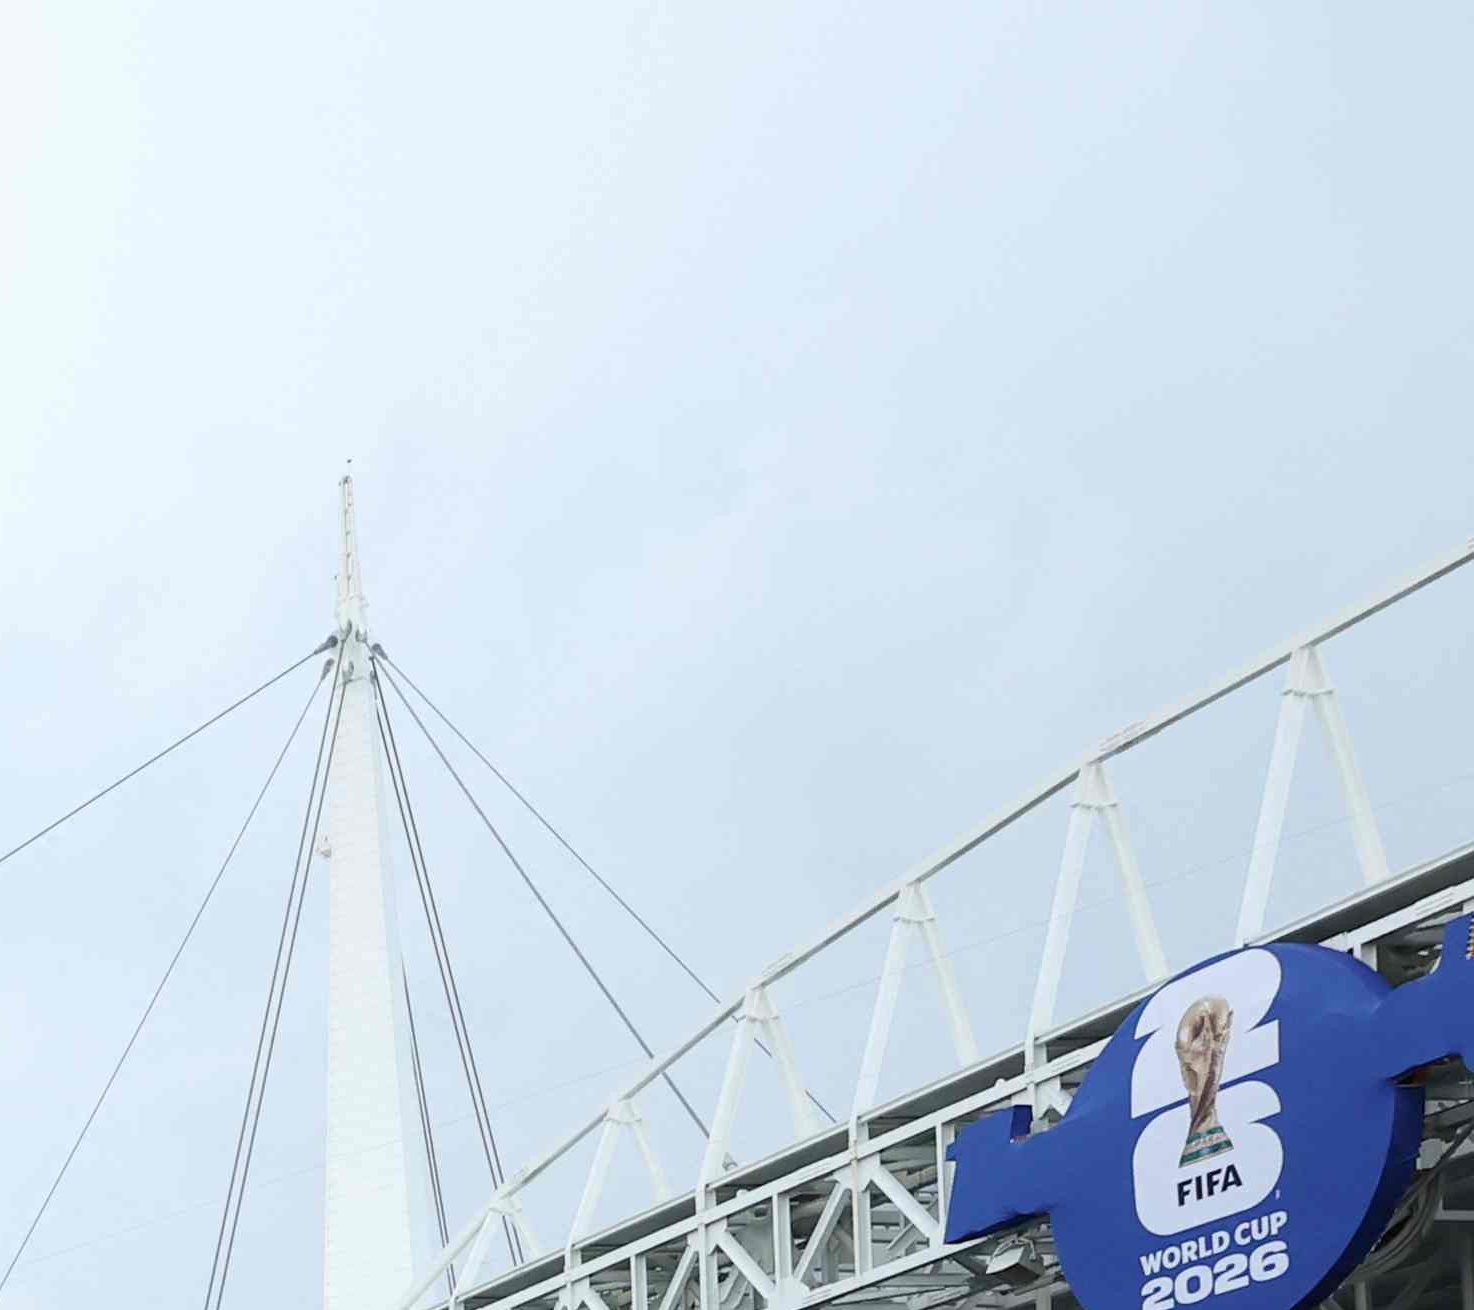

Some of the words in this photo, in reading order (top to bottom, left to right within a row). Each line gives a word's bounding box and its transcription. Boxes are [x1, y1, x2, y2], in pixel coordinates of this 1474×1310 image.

[1177, 1164, 1242, 1207] FIFA
[1140, 1230, 1231, 1276] WORLD
[1234, 1210, 1288, 1246] CUP
